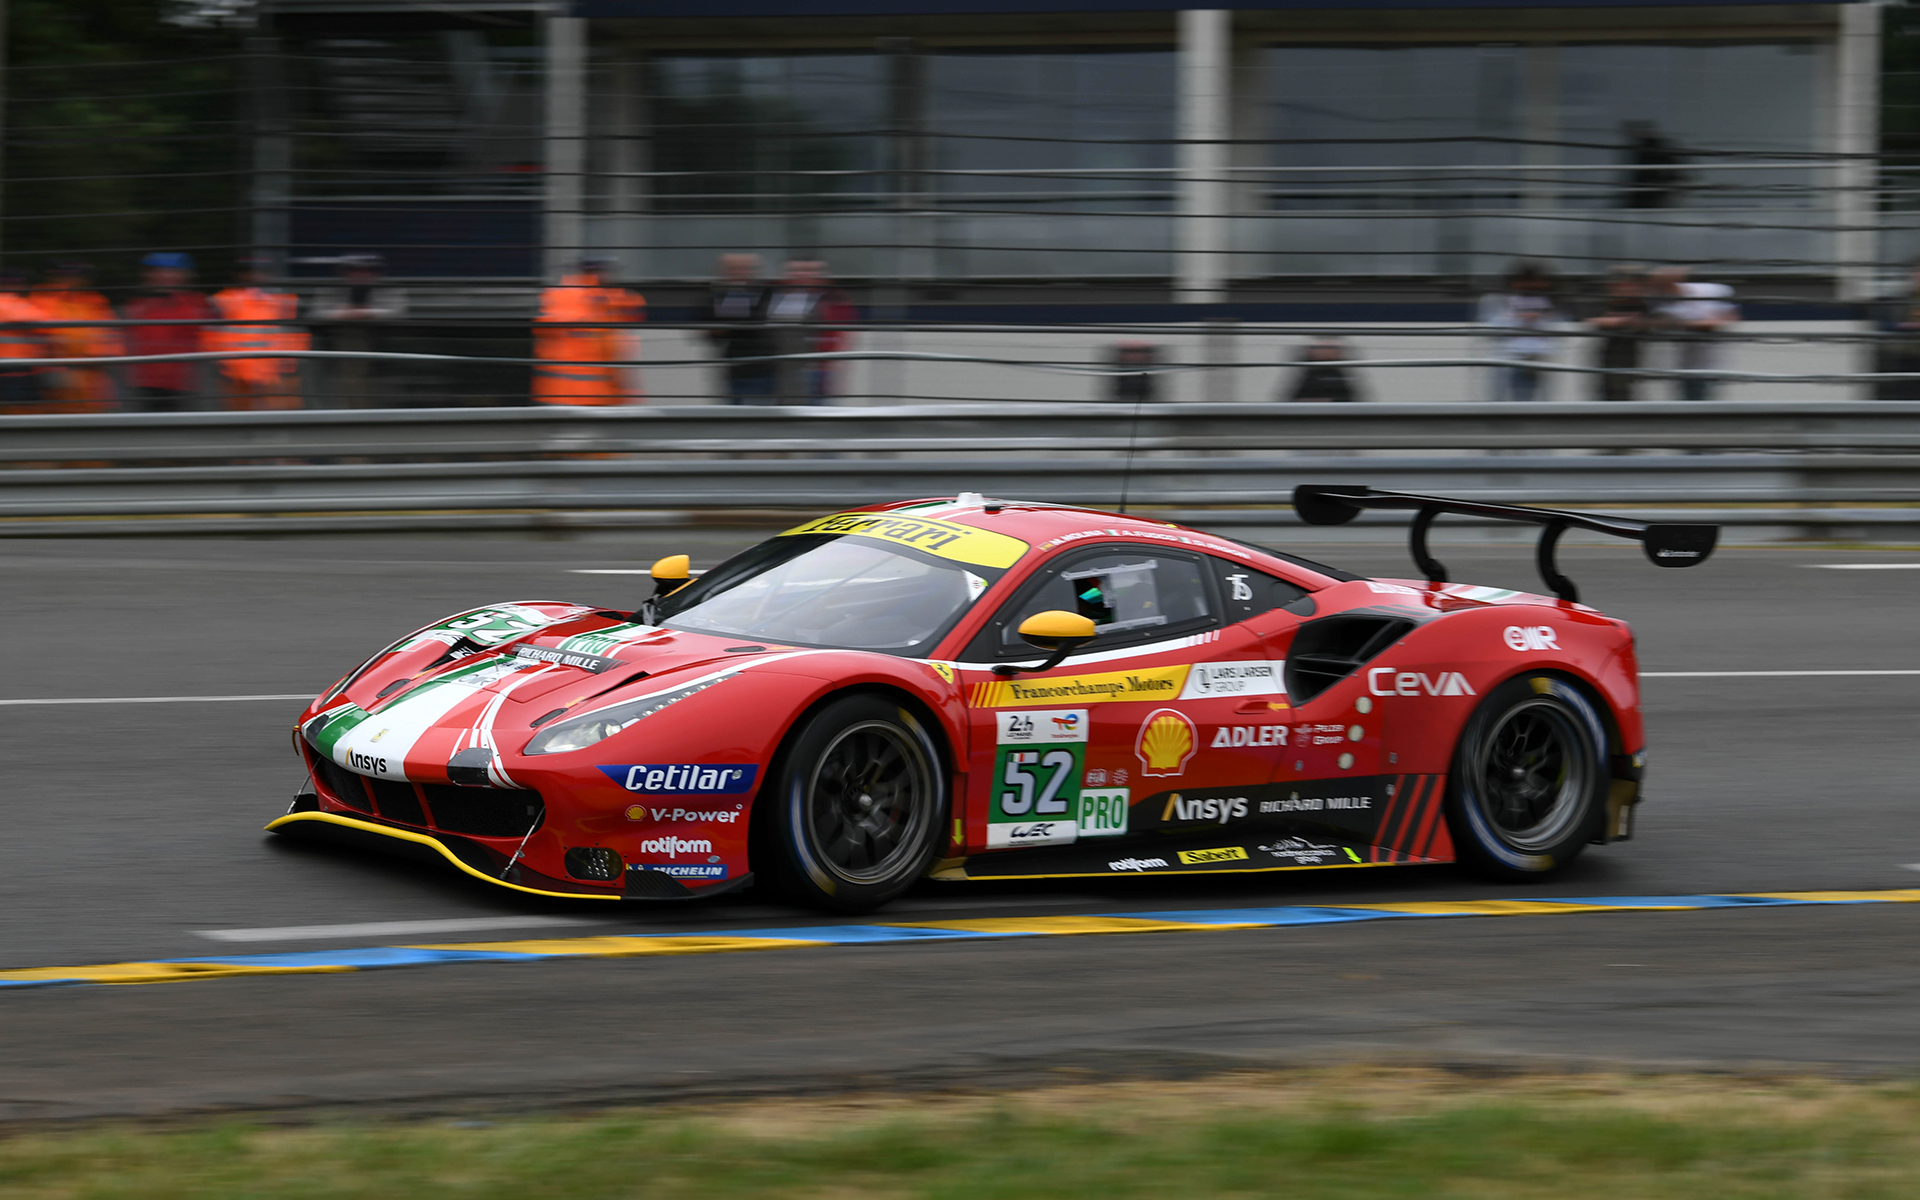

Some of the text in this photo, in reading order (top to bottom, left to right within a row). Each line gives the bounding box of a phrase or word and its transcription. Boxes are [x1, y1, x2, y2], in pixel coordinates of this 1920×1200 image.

[802, 513, 972, 551] Ferrari
[447, 611, 540, 643] 52
[517, 647, 600, 671] RICHARD MILLE
[1211, 666, 1273, 679] LARS LARSEN
[1010, 674, 1174, 699] Francorchamps Motors
[1213, 680, 1246, 693] GROUP
[1210, 725, 1289, 748] ADLER
[345, 747, 387, 776] Ansys
[625, 765, 733, 791] Cetilar
[1001, 749, 1074, 817] 52
[651, 808, 740, 823] V-Power
[1081, 795, 1124, 830] PRO
[1161, 793, 1248, 824] Ansys
[1259, 796, 1372, 813] RICHARD MILLE
[1010, 823, 1055, 838] WEC
[641, 835, 712, 859] rotiform
